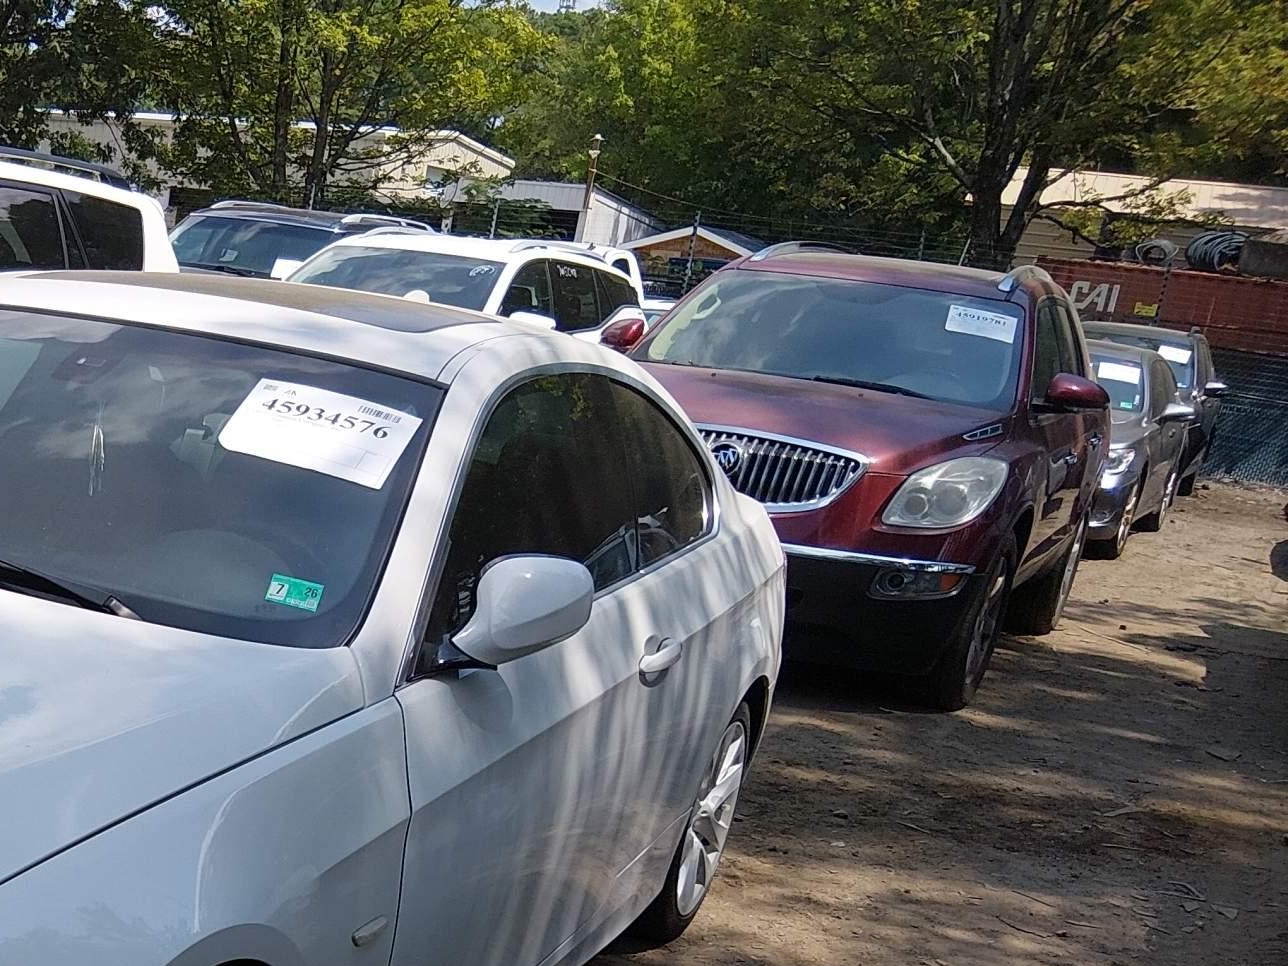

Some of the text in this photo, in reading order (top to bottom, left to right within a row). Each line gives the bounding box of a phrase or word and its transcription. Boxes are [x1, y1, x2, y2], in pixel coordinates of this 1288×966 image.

[1070, 281, 1121, 313] CAI
[261, 397, 393, 441] 45934576
[276, 582, 319, 599] 7 26
